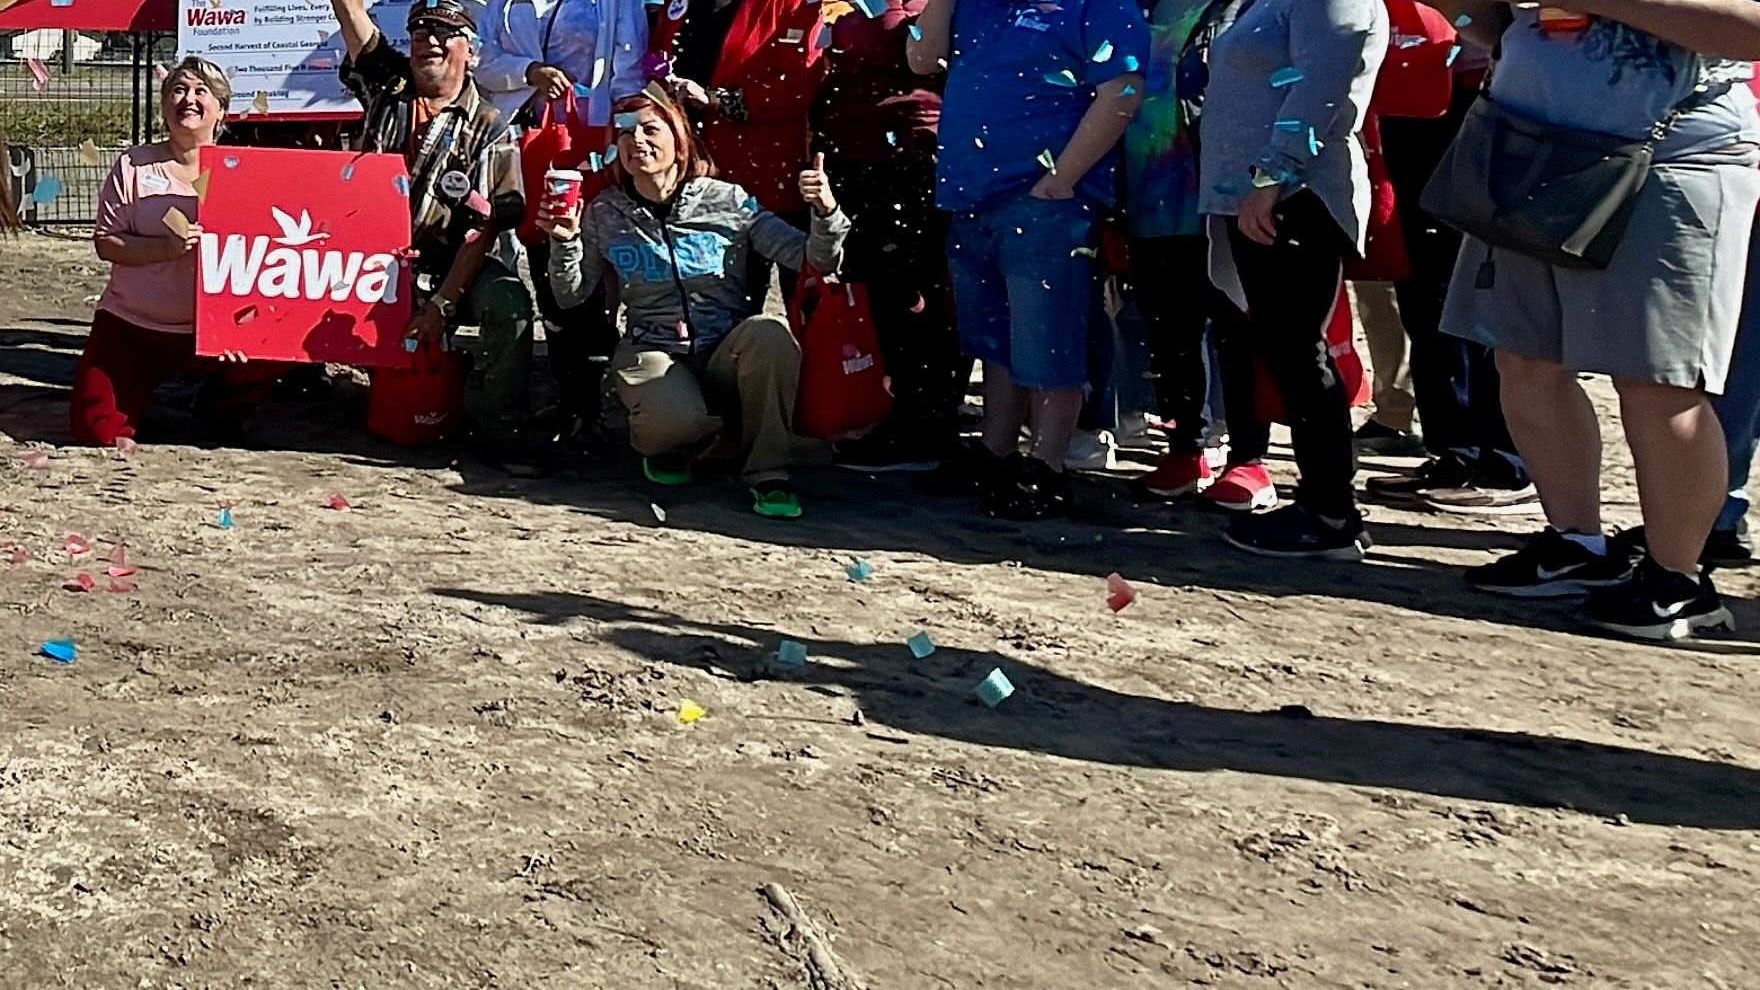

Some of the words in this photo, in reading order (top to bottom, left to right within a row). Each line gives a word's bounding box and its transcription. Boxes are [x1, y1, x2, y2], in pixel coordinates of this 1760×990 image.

[187, 8, 246, 26] Wawa
[254, 16, 262, 25] by
[208, 43, 233, 51] Second
[235, 42, 261, 50] Harvest
[263, 41, 271, 49] of
[272, 40, 299, 49] Coastal
[200, 233, 399, 304] Wawa
